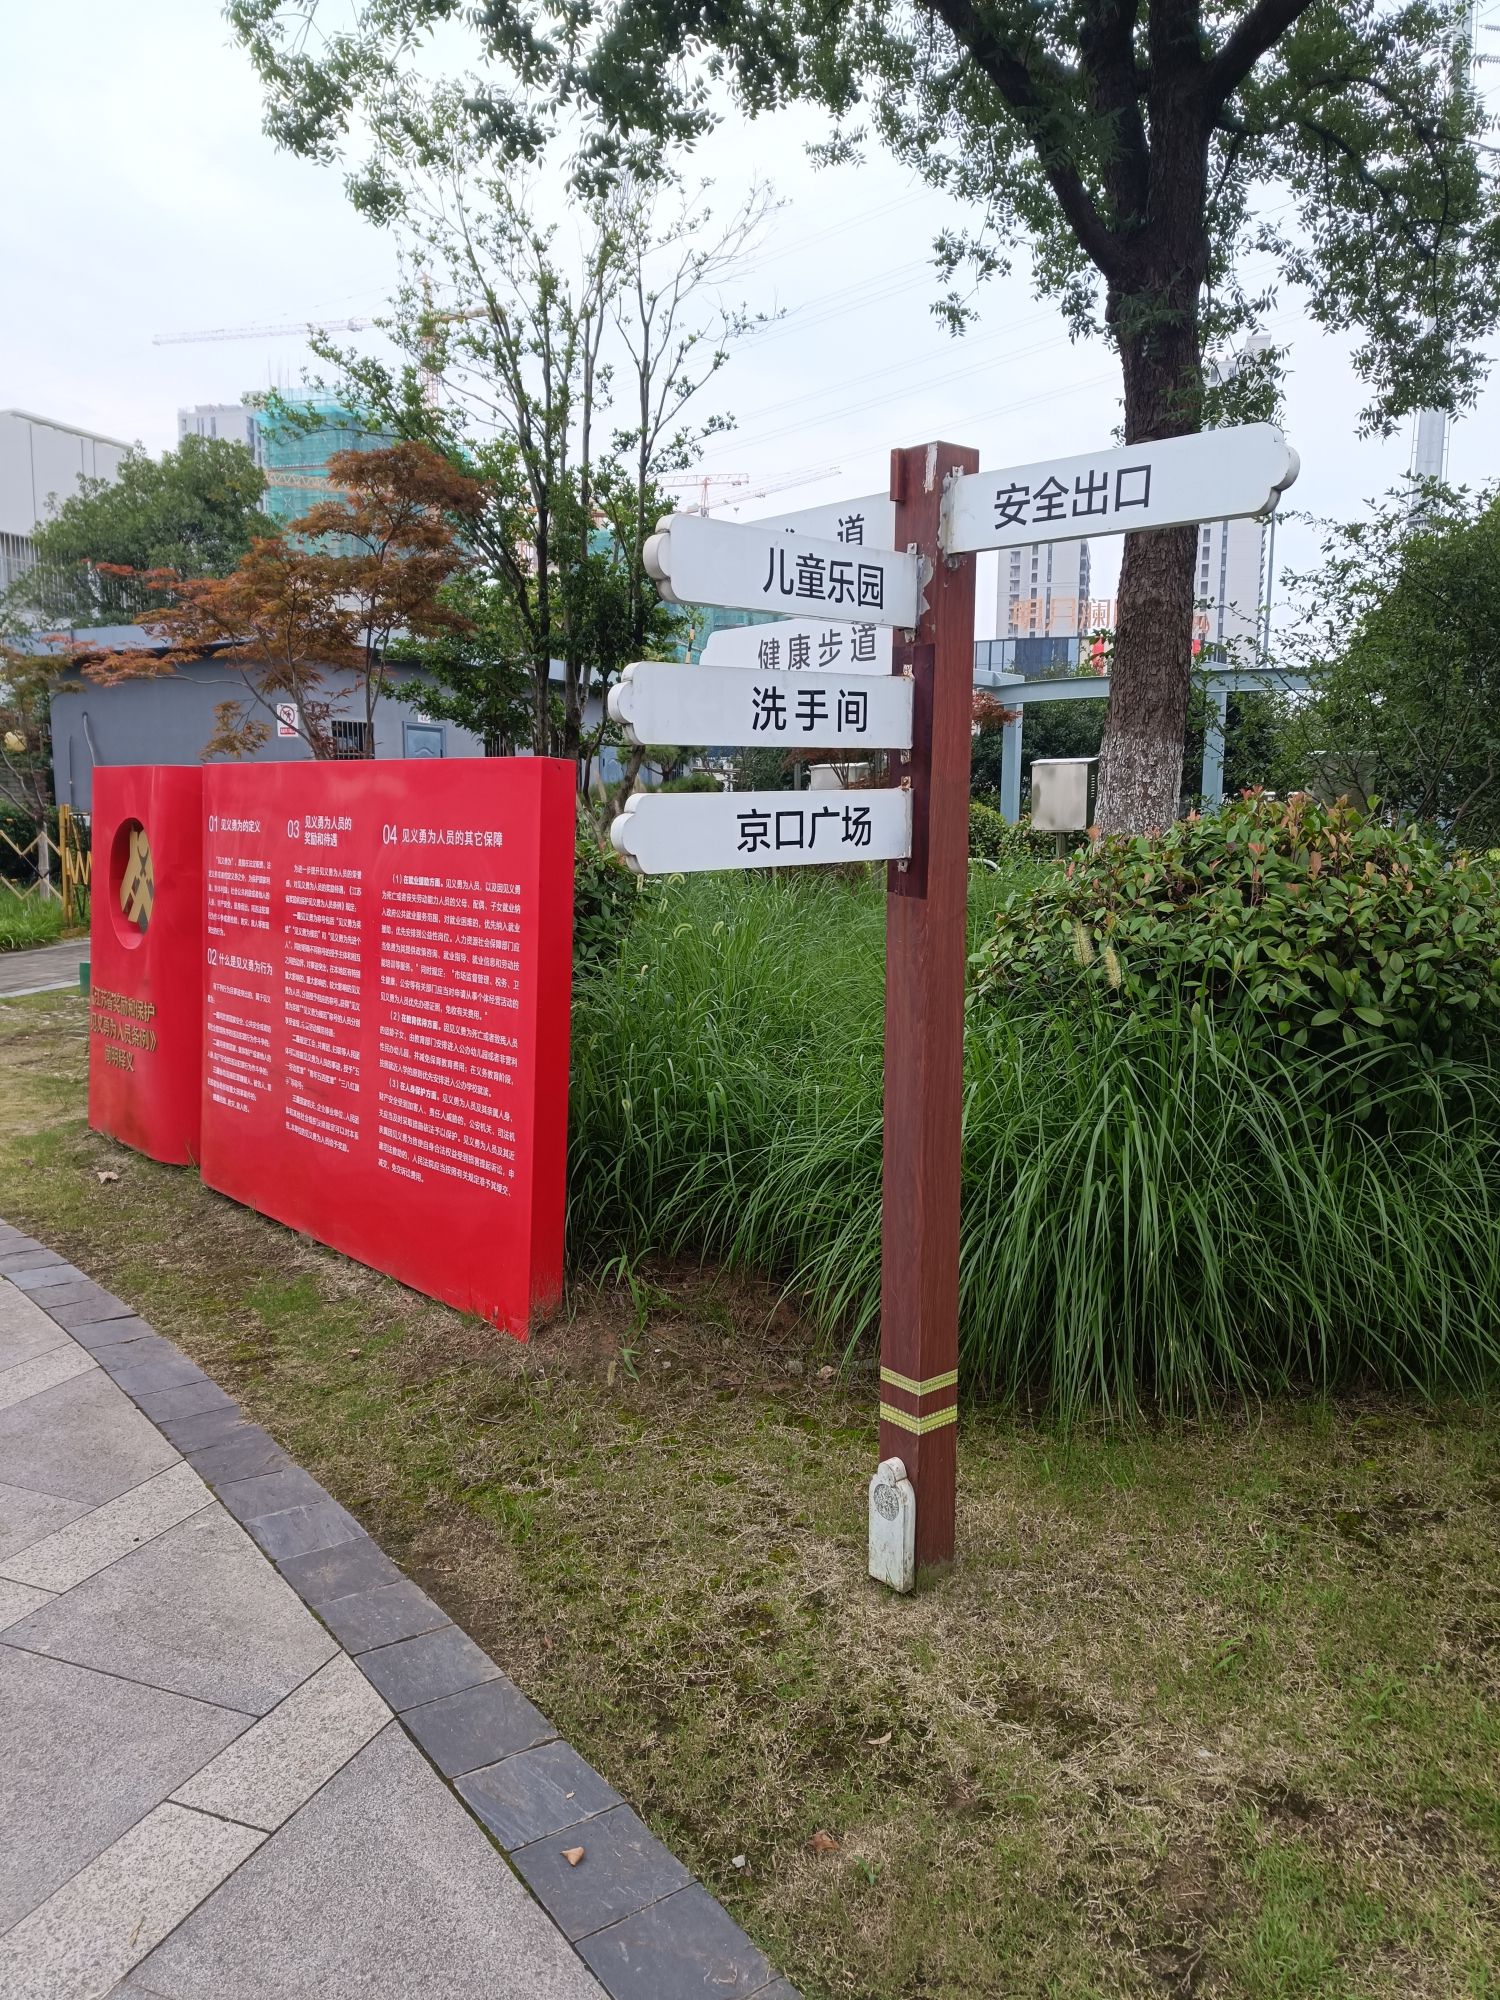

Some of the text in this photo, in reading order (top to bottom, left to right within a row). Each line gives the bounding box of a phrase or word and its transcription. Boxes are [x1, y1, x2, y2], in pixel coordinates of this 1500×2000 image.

[993, 463, 1153, 530] 安全出口
[763, 547, 884, 609] 儿童乐园
[757, 624, 877, 671] 健康步道
[751, 687, 868, 733] 洗手间
[208, 815, 261, 833] 01 见义勇为的定义
[287, 815, 352, 839] 03 见义勇为人员的
[304, 831, 338, 847] 奖励和待遇
[382, 824, 503, 848] 04 见义勇为人员的其它保障
[737, 804, 871, 853] 京口广场
[207, 947, 273, 976] 02 什么是见义勇为行为
